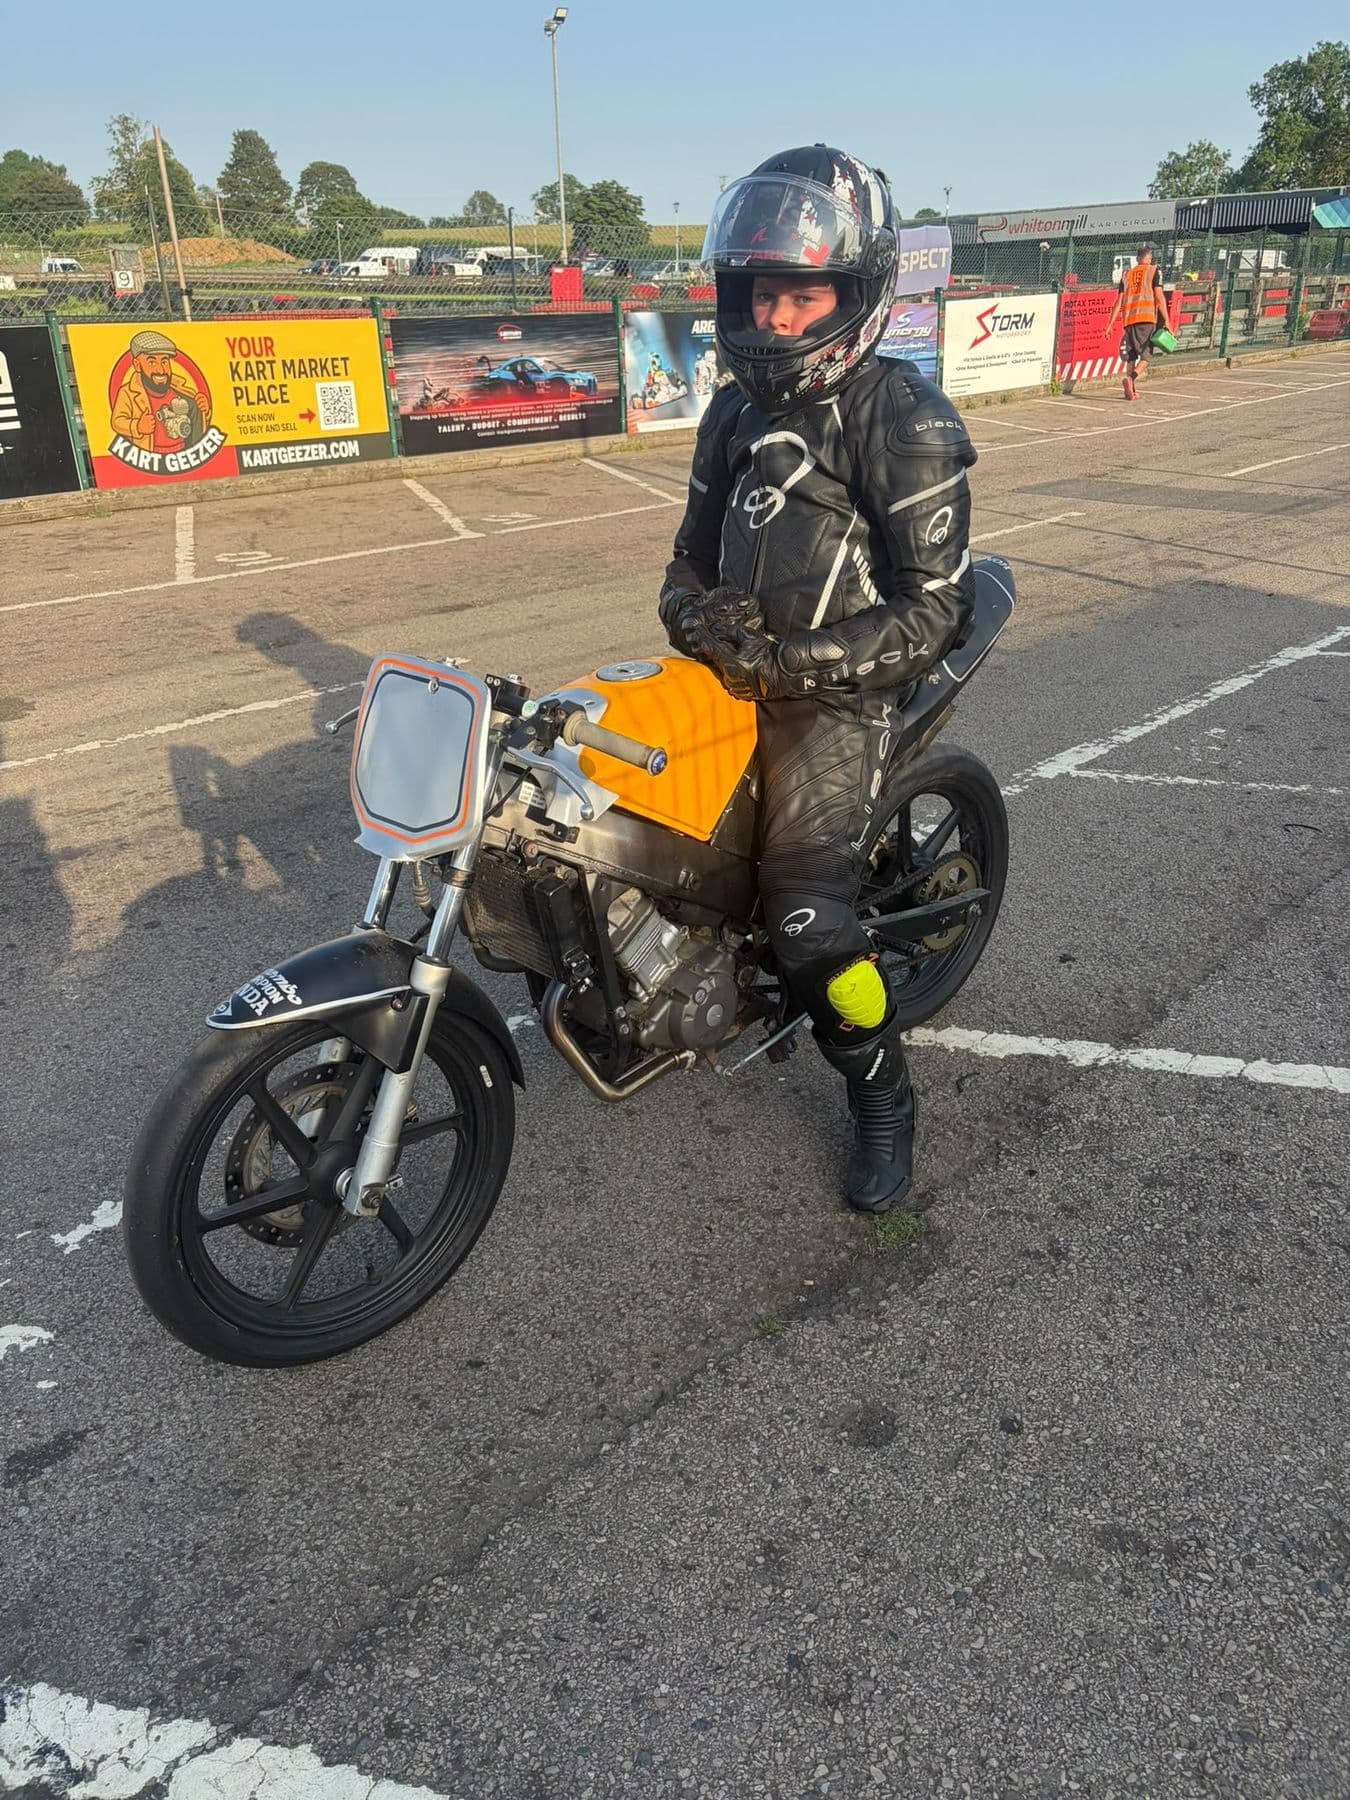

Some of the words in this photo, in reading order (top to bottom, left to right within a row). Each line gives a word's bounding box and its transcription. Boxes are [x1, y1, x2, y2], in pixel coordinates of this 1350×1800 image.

[1090, 221, 1117, 229] KART
[1122, 217, 1167, 227] CIRCUIT
[119, 271, 130, 287] 9
[225, 337, 275, 358] YOUR
[229, 360, 277, 382] KART
[281, 357, 350, 379] MARKET
[233, 384, 290, 407] PLACE
[236, 414, 256, 424] SCAN
[257, 413, 276, 422] NOW
[239, 427, 249, 435] TO
[250, 426, 264, 434] BUY
[265, 424, 281, 432] AND
[281, 423, 298, 431] SELL
[437, 424, 466, 433] TALENT
[472, 420, 500, 430] BUDGET
[507, 415, 553, 426] COMMITMENT
[559, 412, 587, 421] RESULTS
[111, 436, 162, 472] KART
[164, 427, 225, 472] GEEZER
[241, 440, 360, 467] KARTGEEZER.COM
